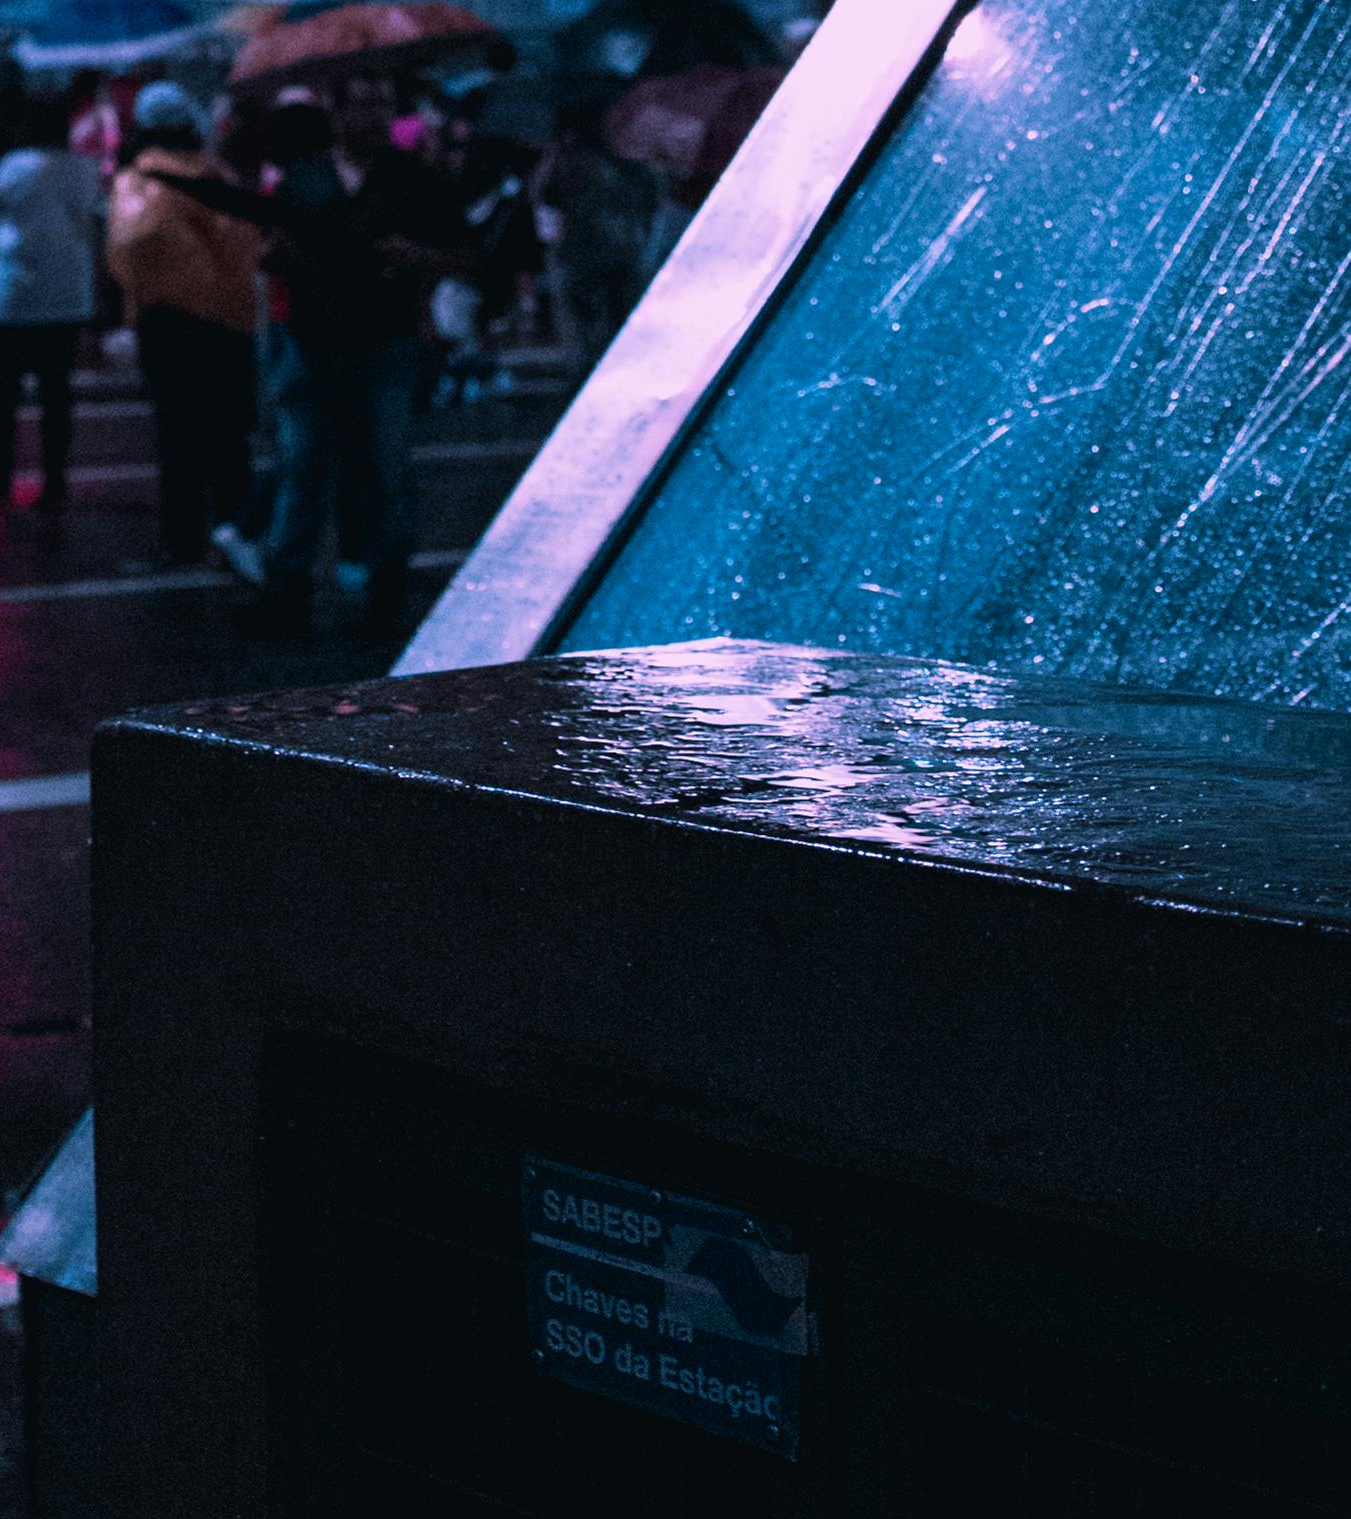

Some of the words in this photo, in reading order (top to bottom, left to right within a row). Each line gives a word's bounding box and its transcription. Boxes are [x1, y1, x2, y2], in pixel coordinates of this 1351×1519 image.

[542, 1188, 662, 1248] SABESP
[544, 1269, 650, 1329] Chaves
[658, 1309, 694, 1343] na
[546, 1318, 606, 1365] SSO
[614, 1343, 649, 1380] da
